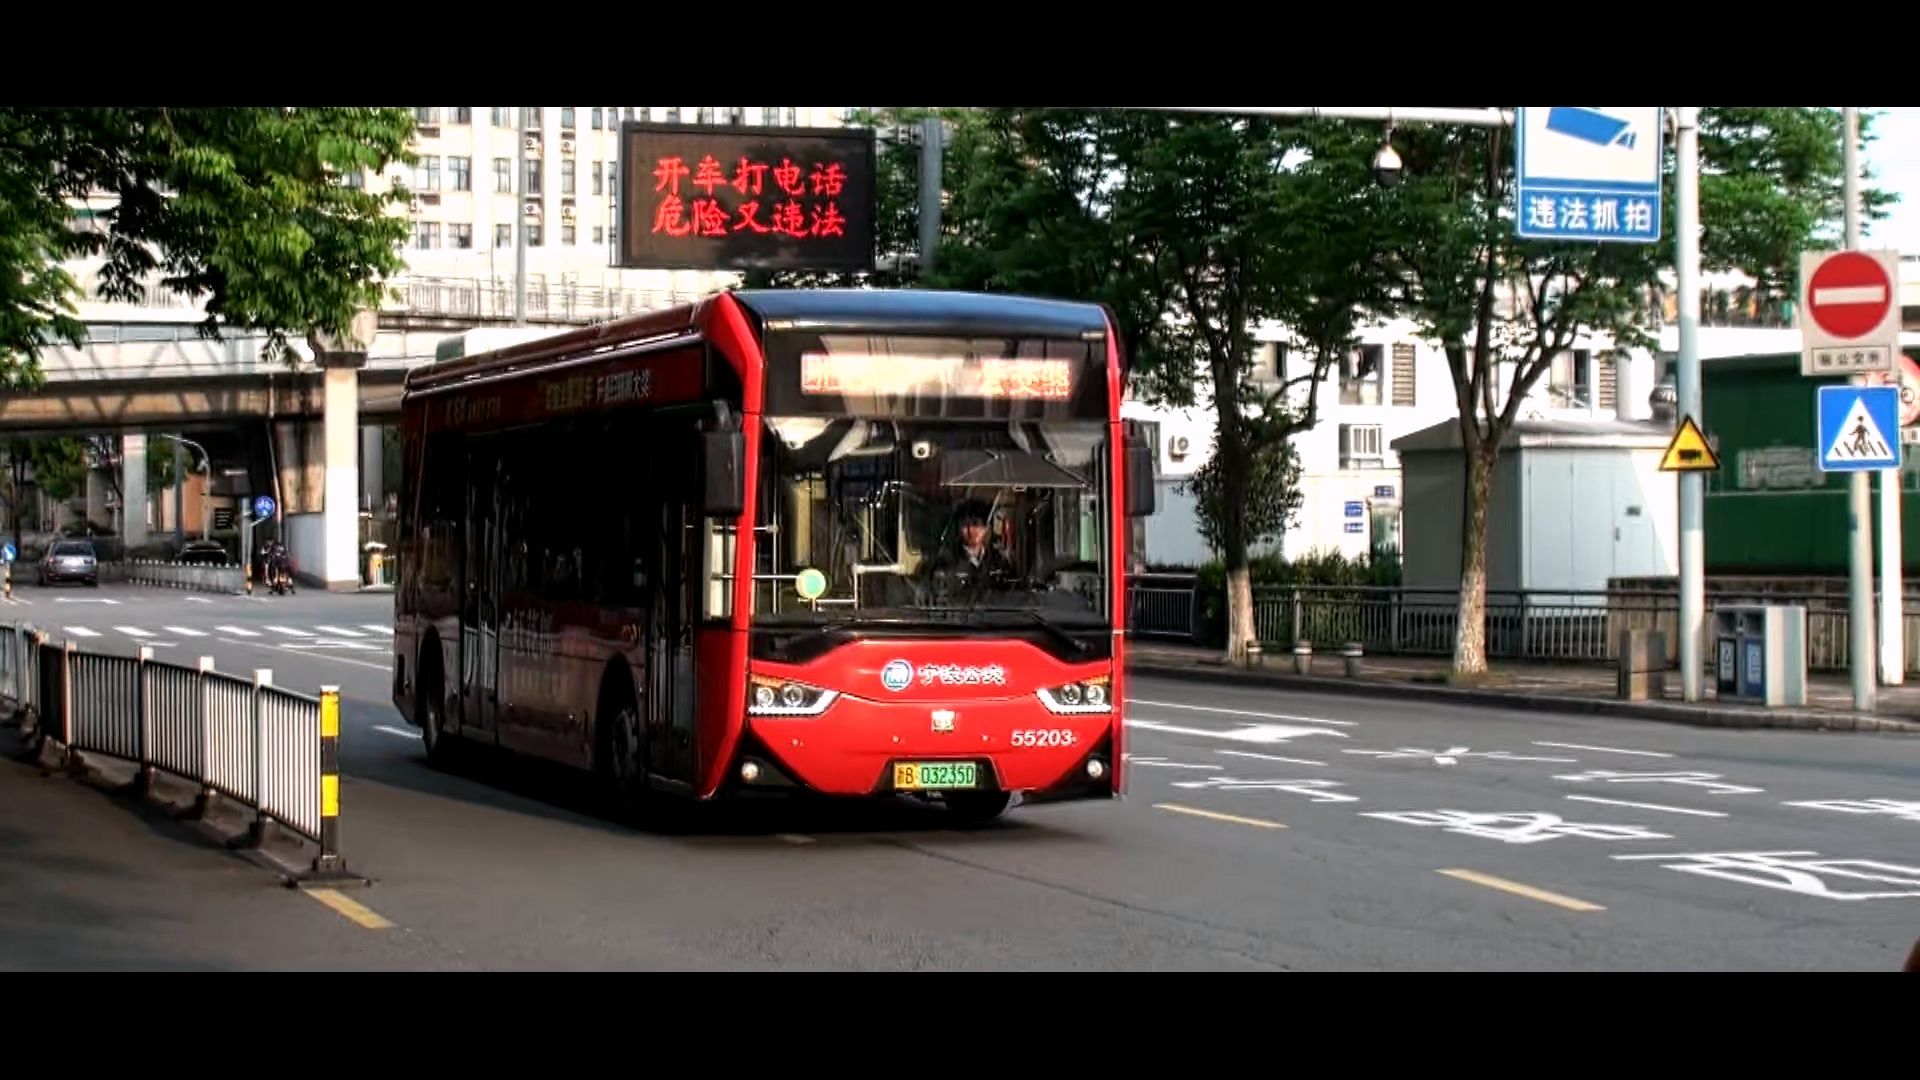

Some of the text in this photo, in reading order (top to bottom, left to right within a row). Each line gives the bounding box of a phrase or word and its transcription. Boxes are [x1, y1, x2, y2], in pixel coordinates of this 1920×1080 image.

[653, 154, 847, 197] 开车打电话
[652, 192, 847, 238] 危险又违法
[1529, 195, 1652, 232] 违法抓拍
[1010, 729, 1072, 747] 55203
